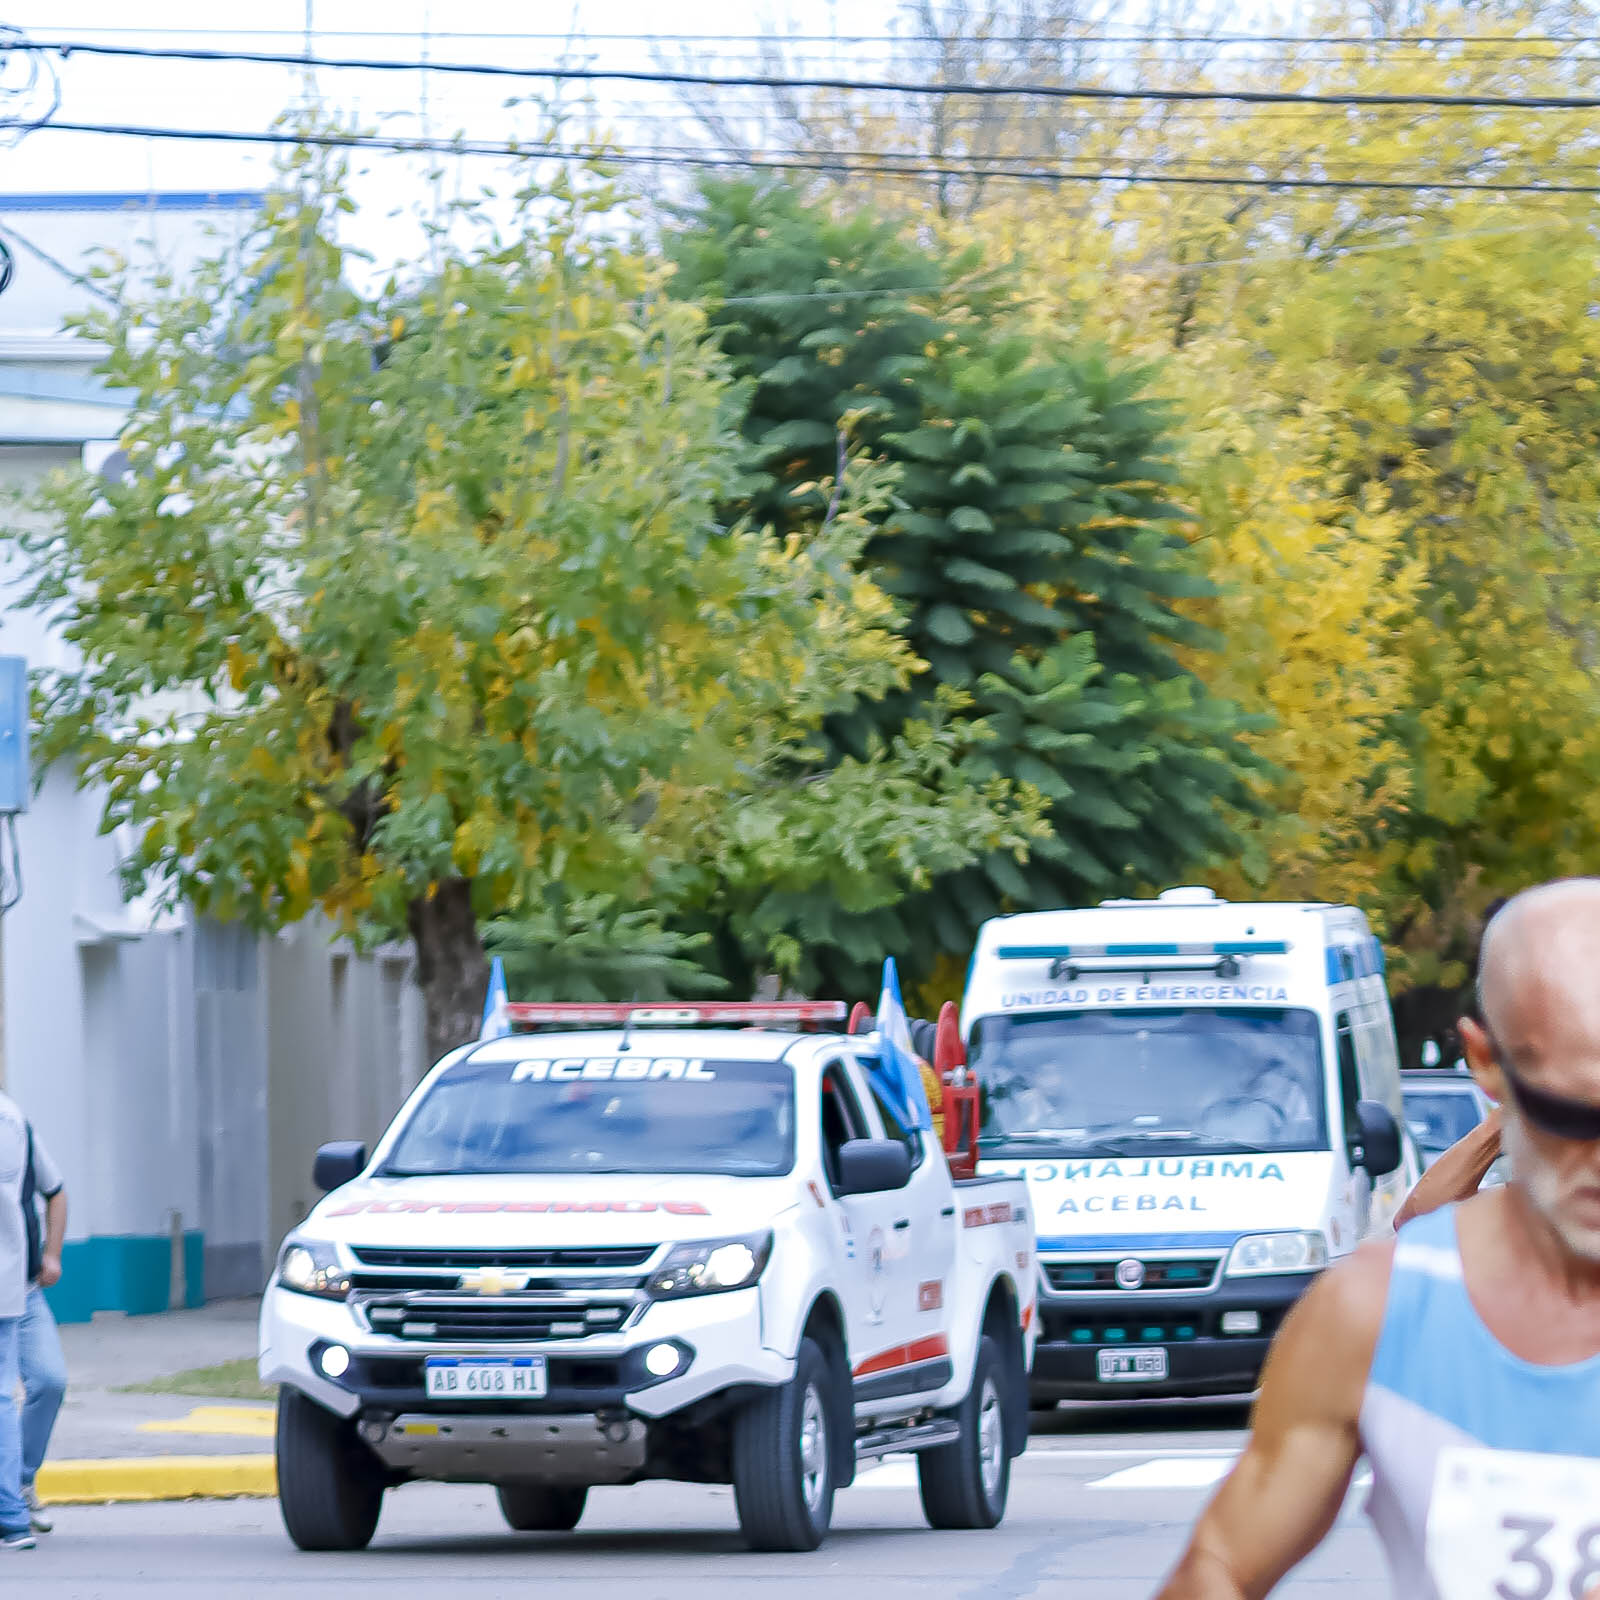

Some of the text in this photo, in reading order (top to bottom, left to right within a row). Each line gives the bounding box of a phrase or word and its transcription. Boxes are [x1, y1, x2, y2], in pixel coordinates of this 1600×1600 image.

[1001, 985, 1288, 1007] UNIDAD DE EMERGENCIA
[510, 1058, 716, 1082] ACEBAL
[1057, 1194, 1208, 1215] ACEBAL
[434, 1370, 458, 1391] AB
